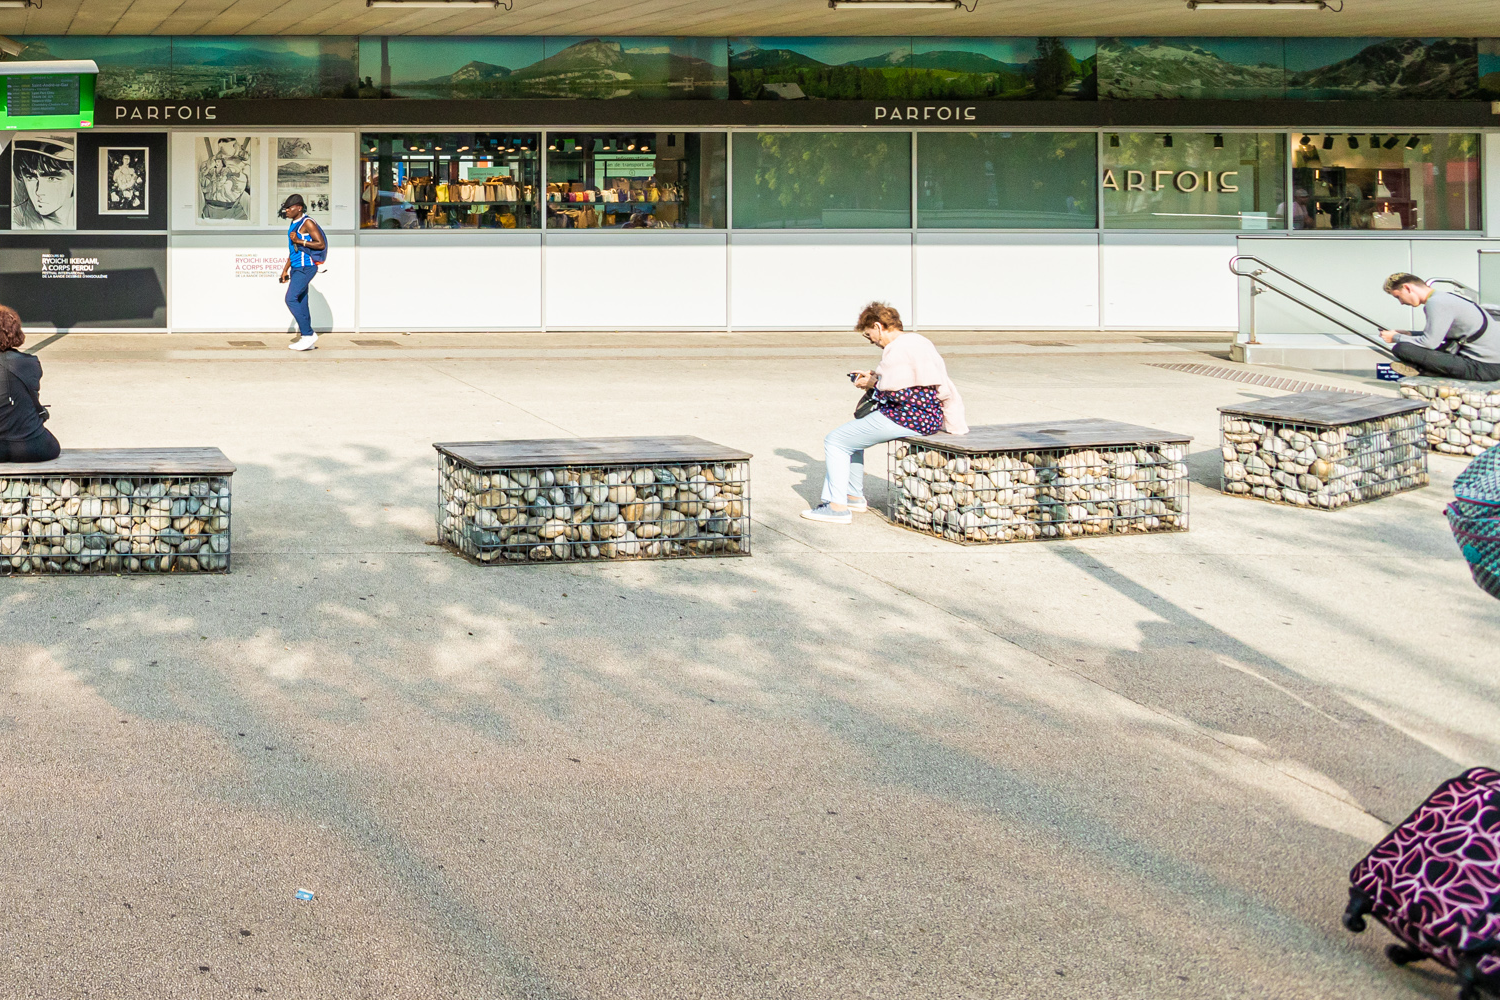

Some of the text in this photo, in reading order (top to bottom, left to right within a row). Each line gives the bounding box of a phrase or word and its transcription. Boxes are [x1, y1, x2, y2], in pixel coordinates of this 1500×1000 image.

[116, 106, 216, 120] PARFOIS
[874, 106, 976, 120] PARFOIS
[1102, 169, 1238, 192] ARFOIS
